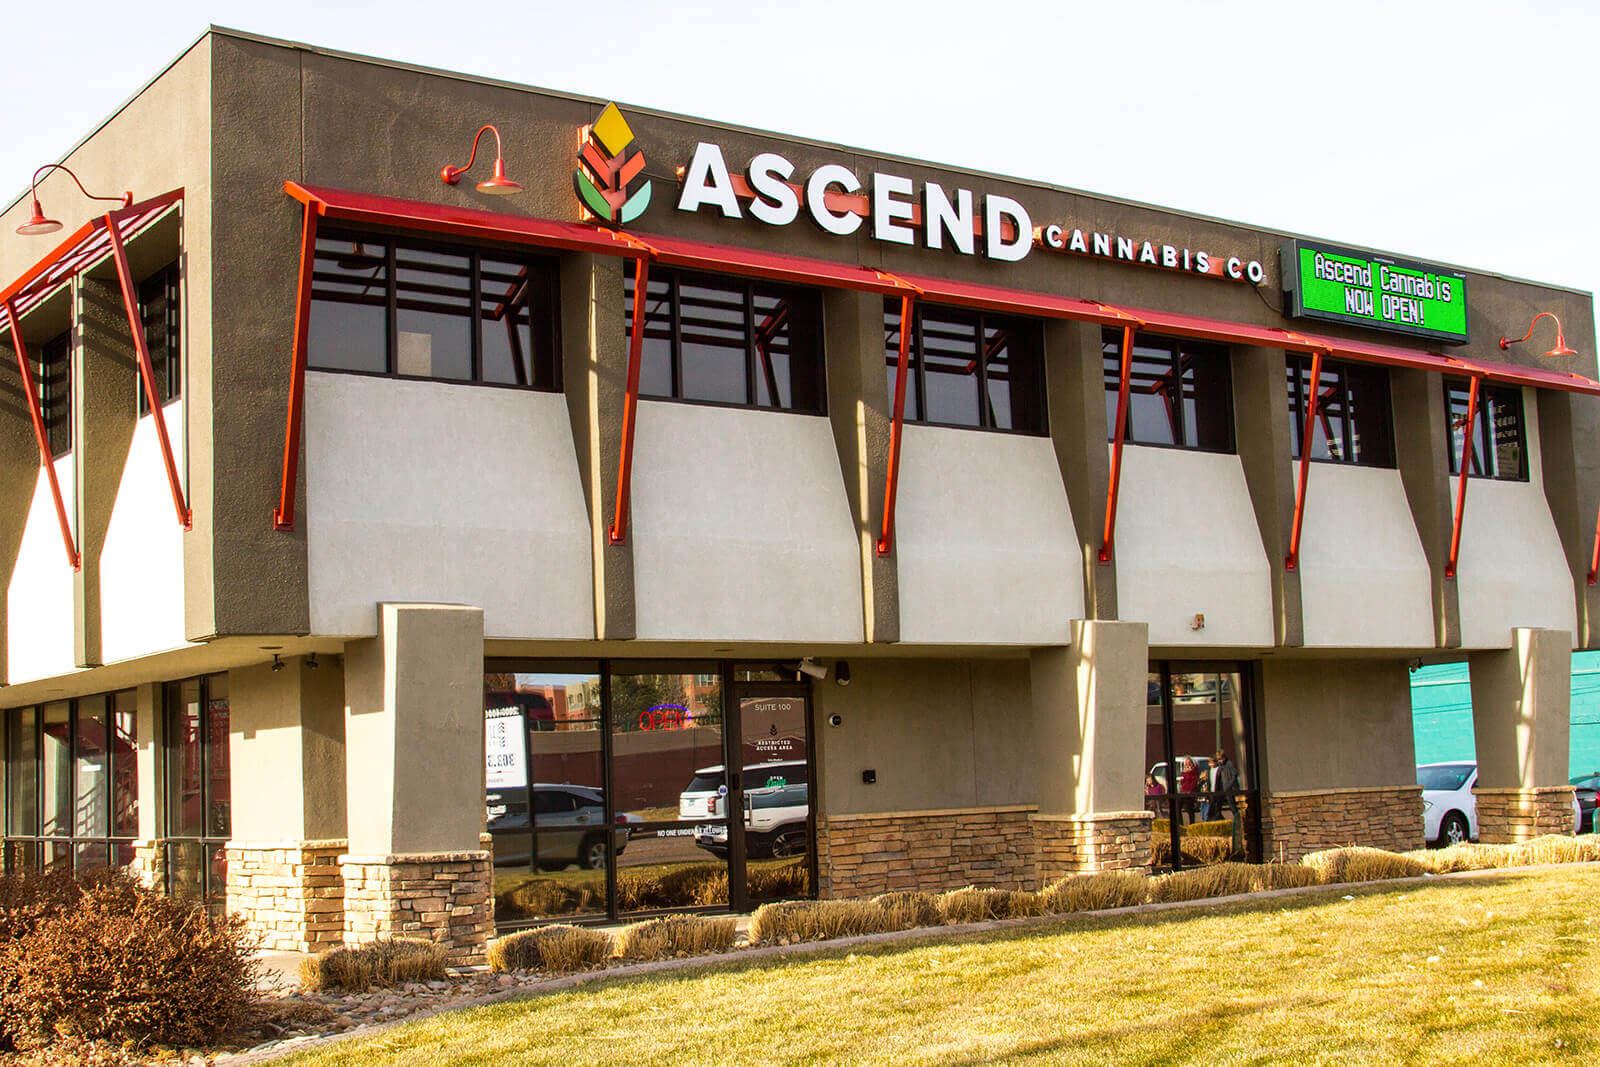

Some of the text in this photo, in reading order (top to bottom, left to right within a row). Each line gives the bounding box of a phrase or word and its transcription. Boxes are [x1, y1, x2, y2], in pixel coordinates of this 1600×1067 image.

[677, 142, 1033, 262] ASCEND
[1045, 224, 1211, 274] CANNABIS
[1314, 252, 1451, 302] Ascend Cannabis
[1344, 286, 1425, 326] NOW OPEN!
[639, 711, 687, 731] OPEN
[779, 703, 791, 711] 100
[657, 829, 666, 837] NO
[666, 829, 677, 837] ONE
